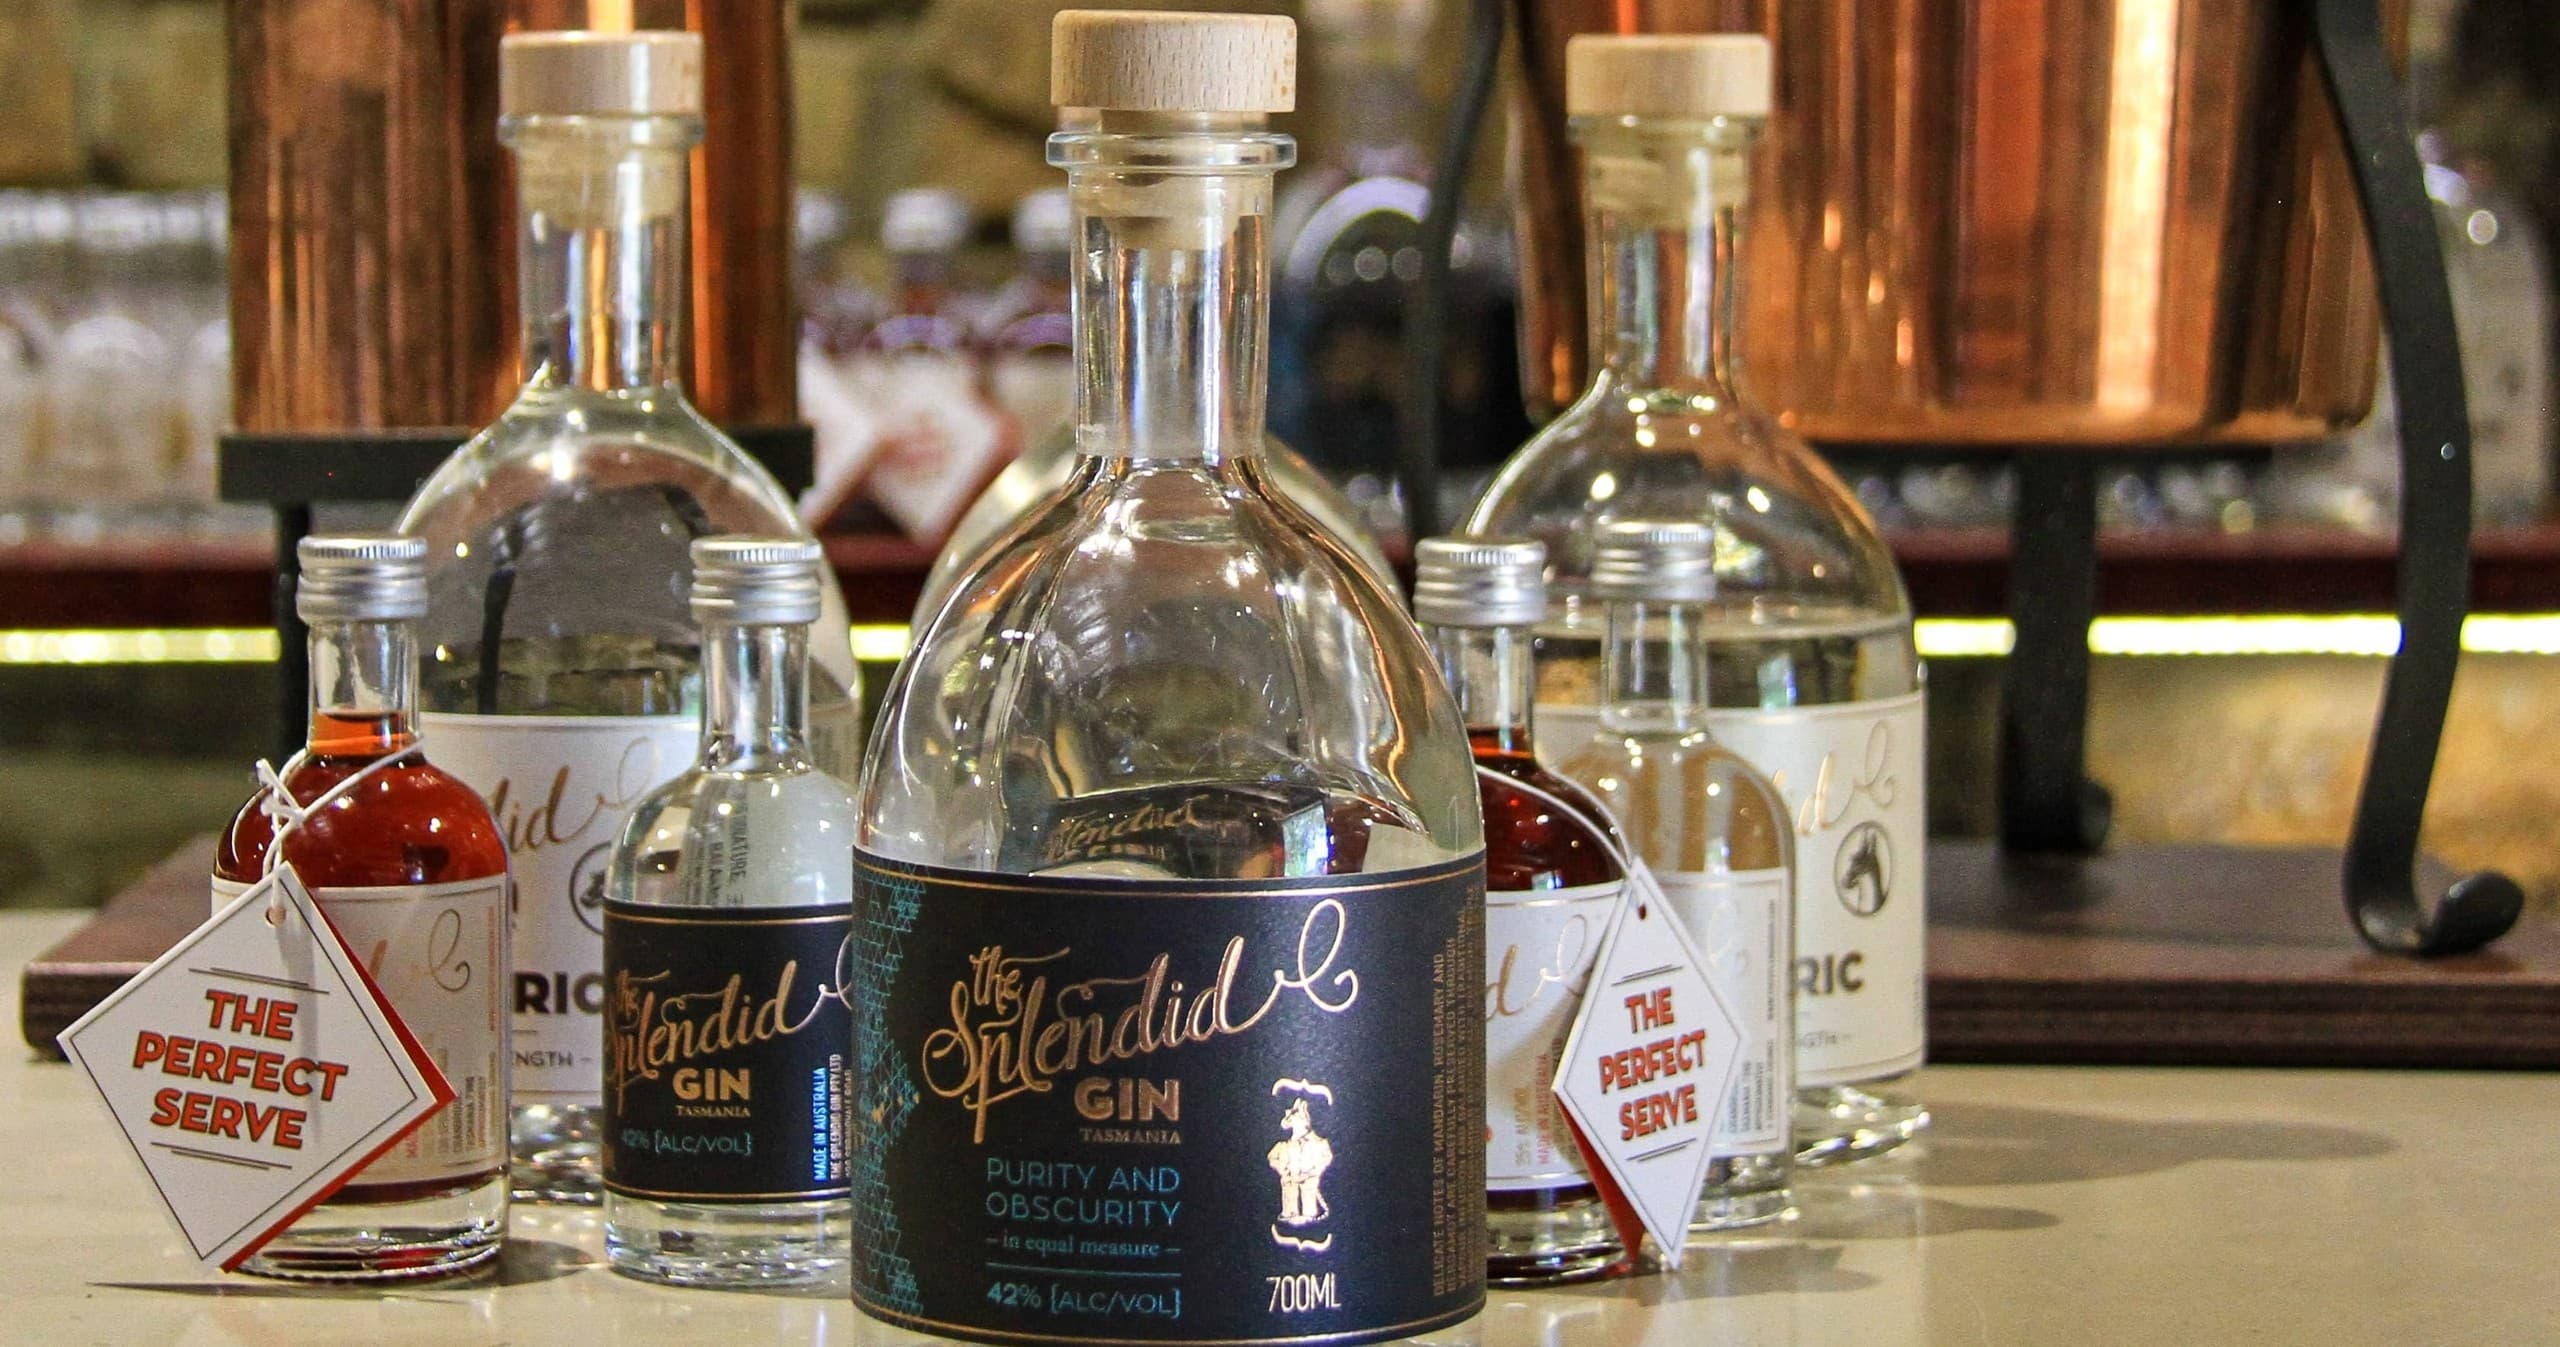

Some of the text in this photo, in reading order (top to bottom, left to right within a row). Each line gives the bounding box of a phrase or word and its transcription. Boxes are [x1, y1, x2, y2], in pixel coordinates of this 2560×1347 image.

[969, 945, 1062, 1013] the
[1433, 954, 1445, 983] AND
[1446, 937, 1456, 1006] THROUGH
[1793, 951, 1864, 996] RIC
[206, 989, 298, 1041] THE
[513, 970, 602, 1015] RIC
[1624, 987, 1675, 1034] THE
[923, 898, 1360, 1144] Splendid
[1433, 988, 1445, 1064] ROSEMARY
[132, 1030, 349, 1101] PERFECT
[672, 1067, 750, 1101] GIN
[1598, 1028, 1706, 1094] PERFECT
[150, 1087, 308, 1149] SERVE
[676, 1104, 751, 1118] TASMANIA
[830, 1054, 842, 1180] THE SPLENDID GIN PTY LTD
[1075, 1077, 1180, 1121] GIN
[1619, 1083, 1698, 1141] SERVE
[812, 1067, 827, 1181] MADE IN AUSTRALIA
[1079, 1127, 1181, 1145] TASMANIA
[986, 1157, 1181, 1193] PURITY AND
[1433, 1157, 1445, 1173] OF
[985, 1190, 1182, 1226] OBSCURITY
[1433, 1178, 1445, 1225] NOTES
[1003, 1228, 1159, 1257] in equal measure
[1433, 1230, 1445, 1297] DELICATE
[986, 1281, 1043, 1308] 42%
[1265, 1272, 1342, 1312] 700ML
